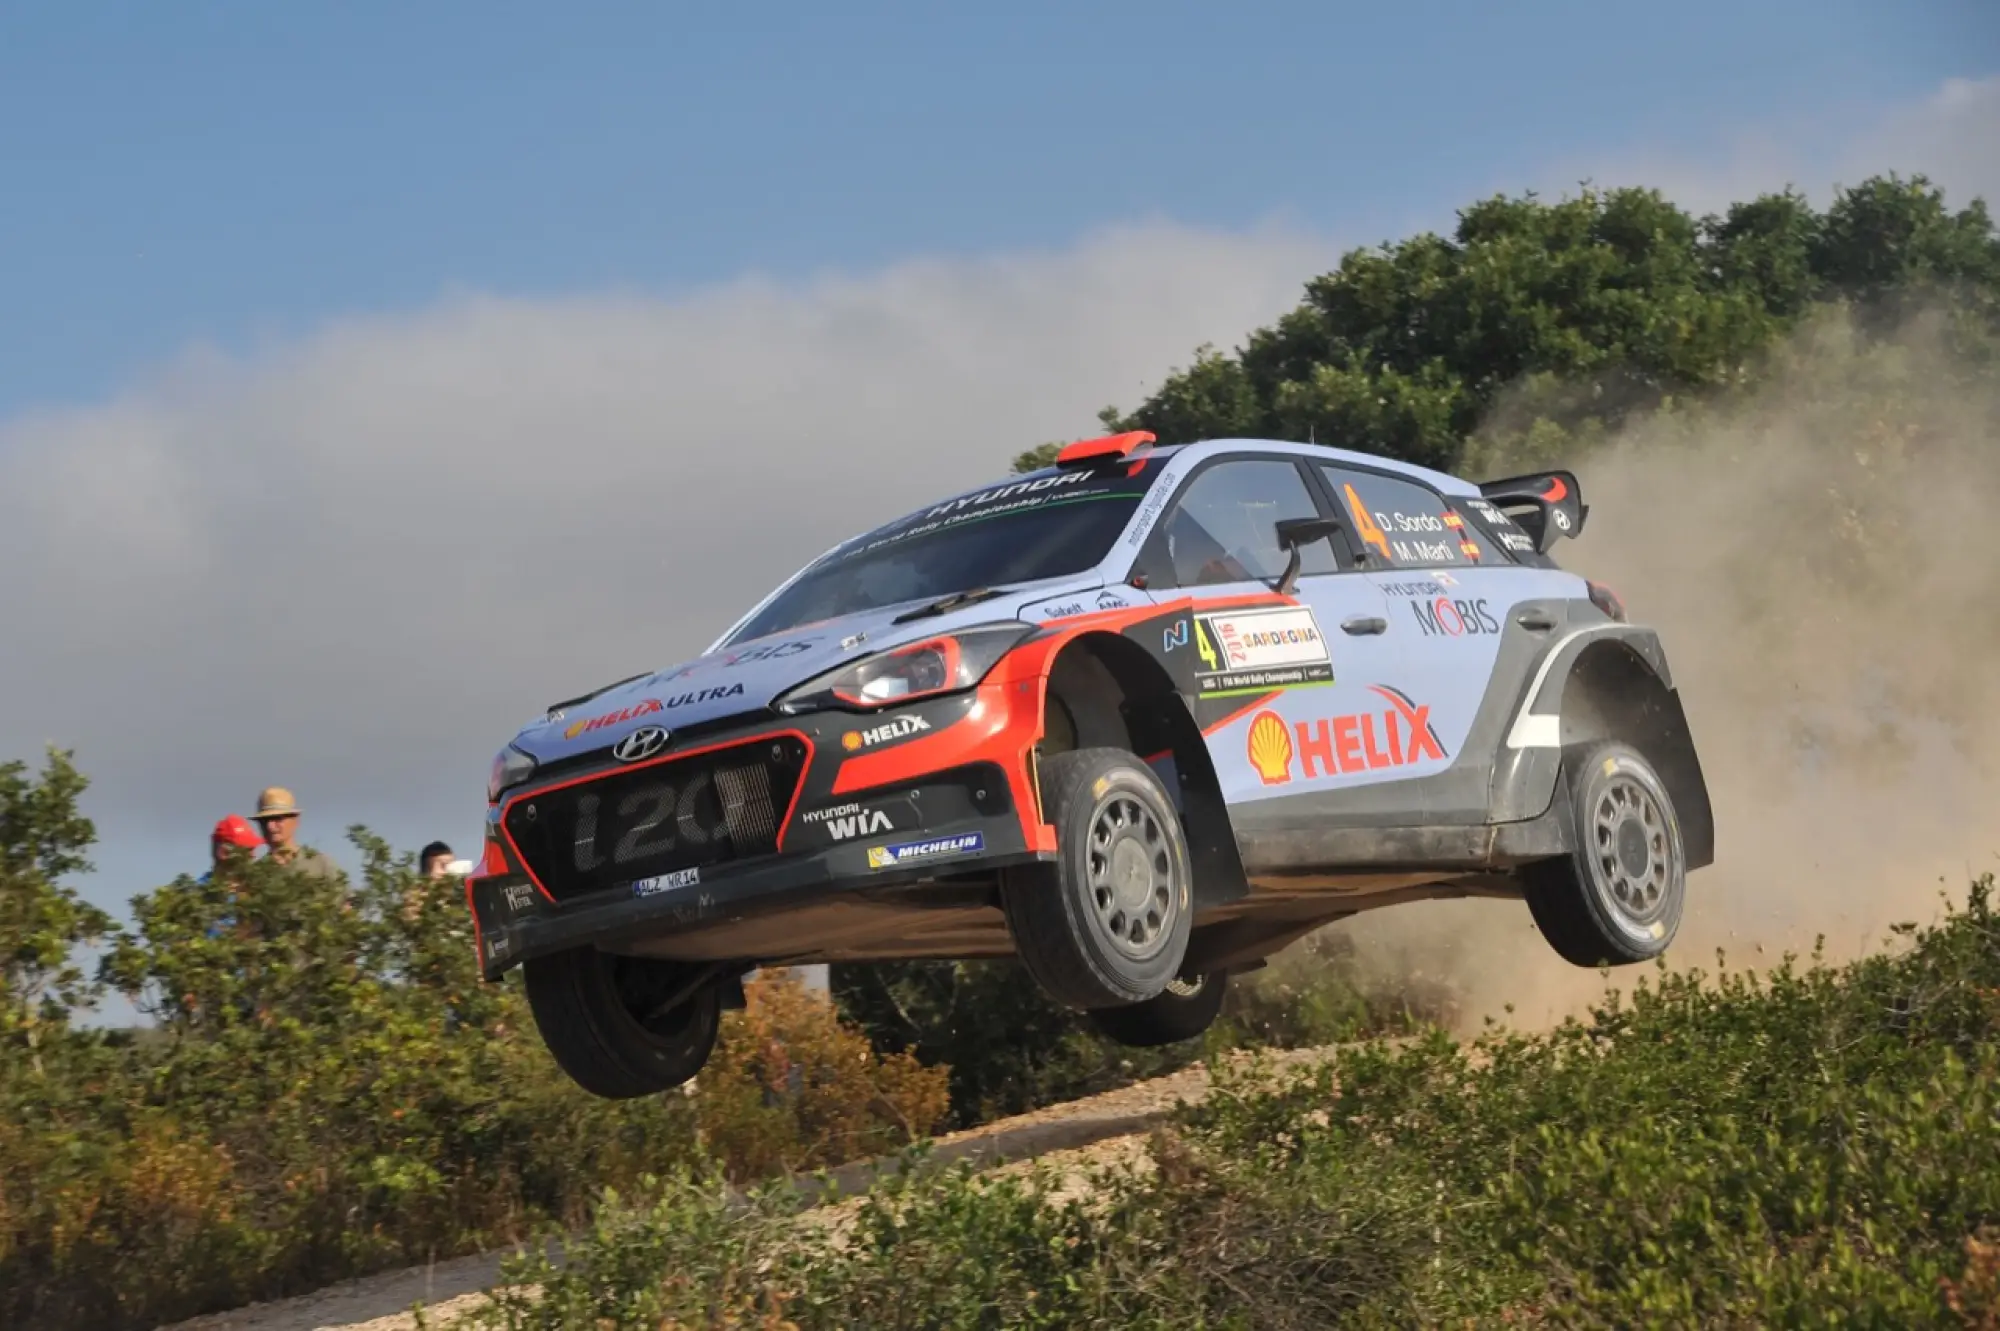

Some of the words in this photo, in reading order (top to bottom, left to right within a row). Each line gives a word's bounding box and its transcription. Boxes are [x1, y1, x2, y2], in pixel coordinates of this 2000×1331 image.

[924, 469, 1095, 520] HYUNDAI
[1343, 483, 1392, 560] 4
[1374, 511, 1398, 532] D.
[1400, 512, 1443, 533] Sordo
[1391, 540, 1416, 561] M.
[1410, 595, 1501, 637] MOBIS
[1193, 618, 1219, 672] 4
[1242, 627, 1318, 649] SARDEGNA
[582, 697, 664, 733] HELIX
[666, 682, 745, 709] ULTRA
[862, 713, 932, 747] HELIX
[1293, 682, 1451, 780] HELIX
[802, 802, 861, 825] HYUNDAI
[897, 834, 977, 859] MICHELIN
